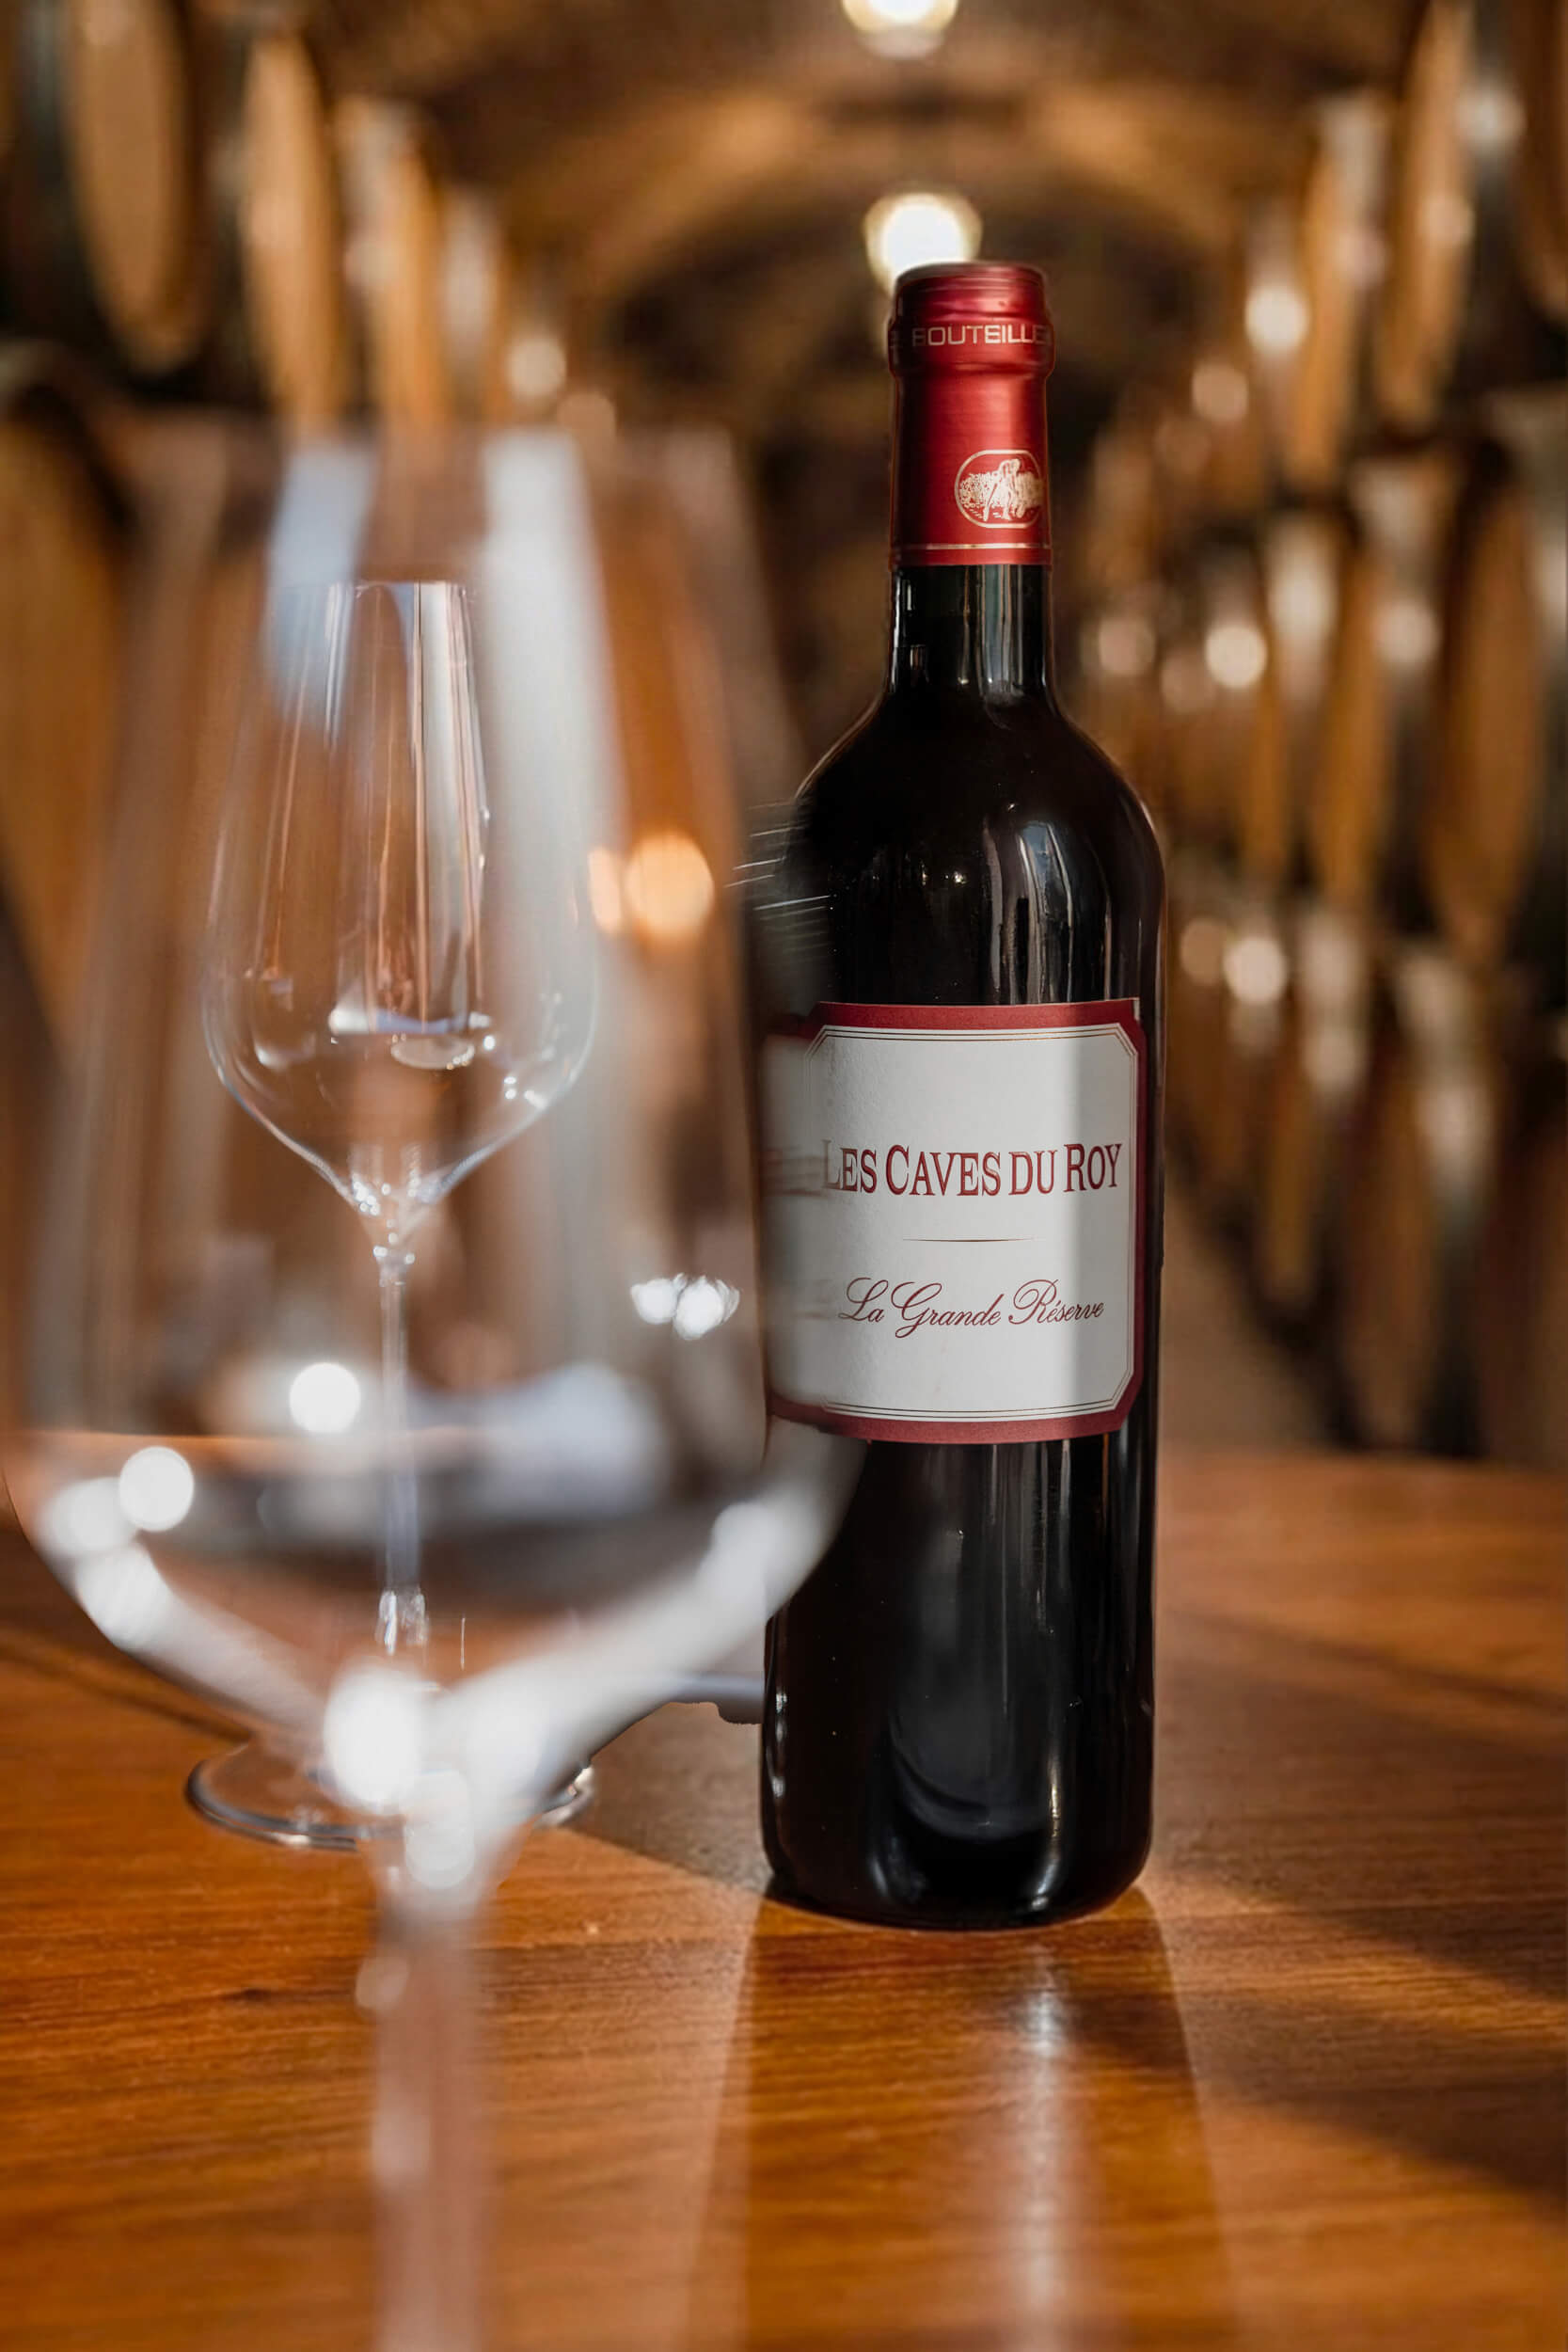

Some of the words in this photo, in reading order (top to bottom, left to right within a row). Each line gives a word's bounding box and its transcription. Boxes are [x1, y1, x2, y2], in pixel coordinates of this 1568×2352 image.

[821, 1139, 878, 1194] LES
[885, 1144, 1001, 1197] CAVES
[1008, 1150, 1058, 1195] DU
[1063, 1143, 1122, 1193] ROY
[838, 1277, 889, 1323] La
[891, 1281, 1005, 1338] Grande
[1008, 1279, 1105, 1325] Réserve
